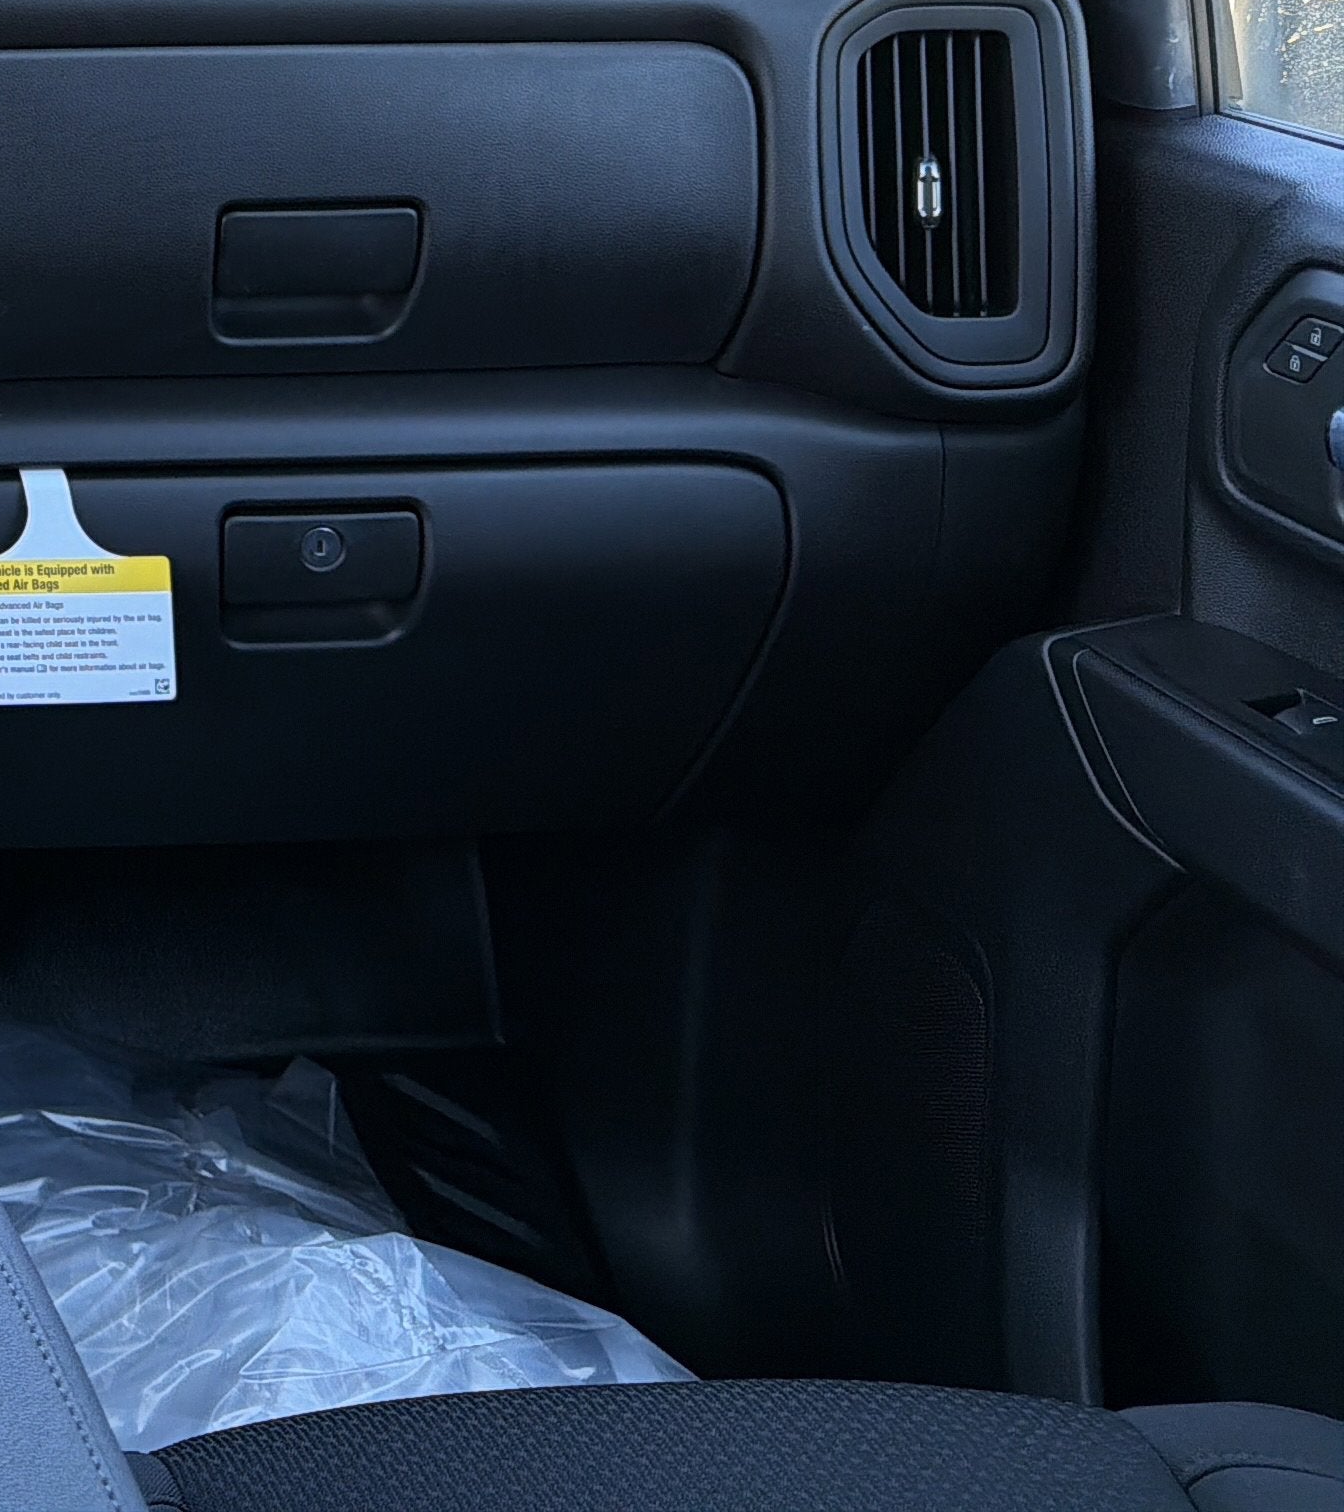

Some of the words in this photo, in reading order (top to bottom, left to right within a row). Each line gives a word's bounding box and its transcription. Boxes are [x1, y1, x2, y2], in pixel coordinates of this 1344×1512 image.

[24, 564, 34, 576] is
[36, 563, 88, 579] Equipped
[90, 563, 115, 575] with
[13, 578, 29, 591] Air
[32, 578, 60, 593] Bags
[33, 601, 43, 610] Air
